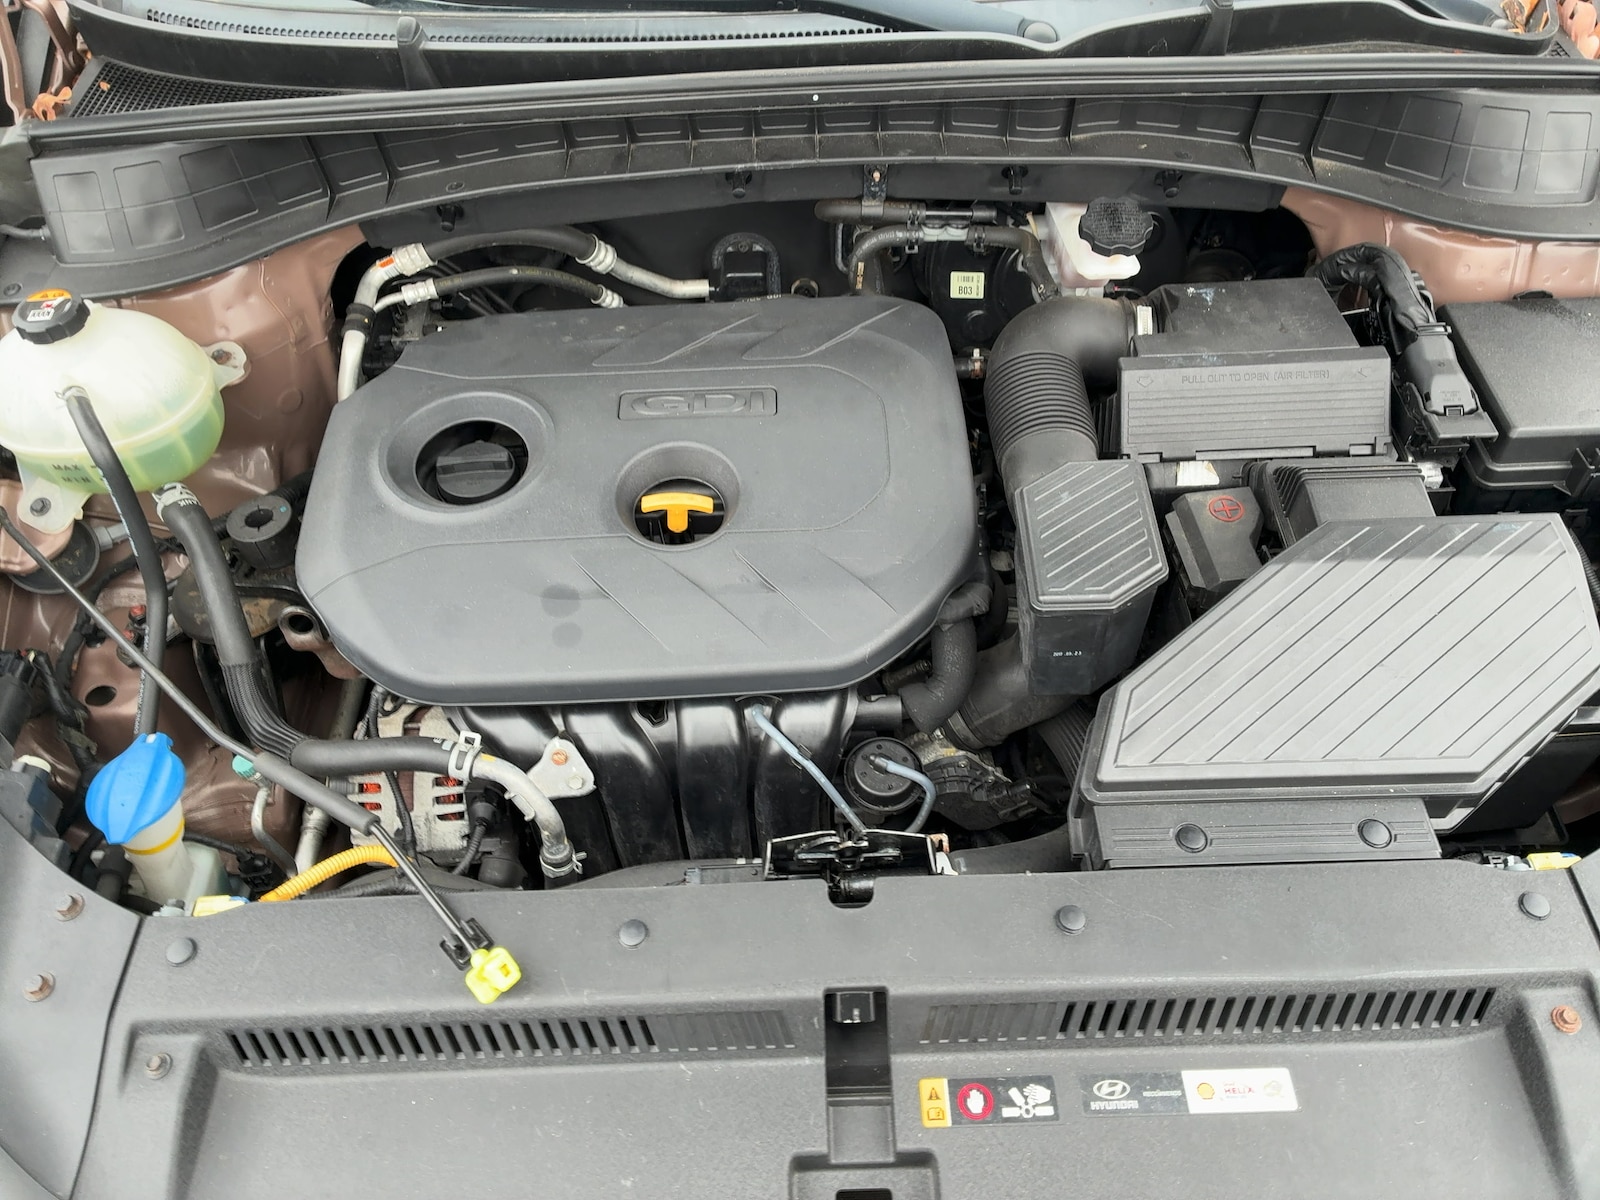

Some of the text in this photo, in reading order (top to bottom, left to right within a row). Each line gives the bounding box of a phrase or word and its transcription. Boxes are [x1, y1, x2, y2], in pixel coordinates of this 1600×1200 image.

[958, 285, 973, 296] B03
[1181, 369, 1330, 385] PULL OUT TO OPEN (AIR FILTER)
[631, 391, 765, 416] GDI
[51, 463, 81, 472] MAX
[61, 475, 92, 484] MIN
[1089, 1099, 1139, 1111] HYUNDAI
